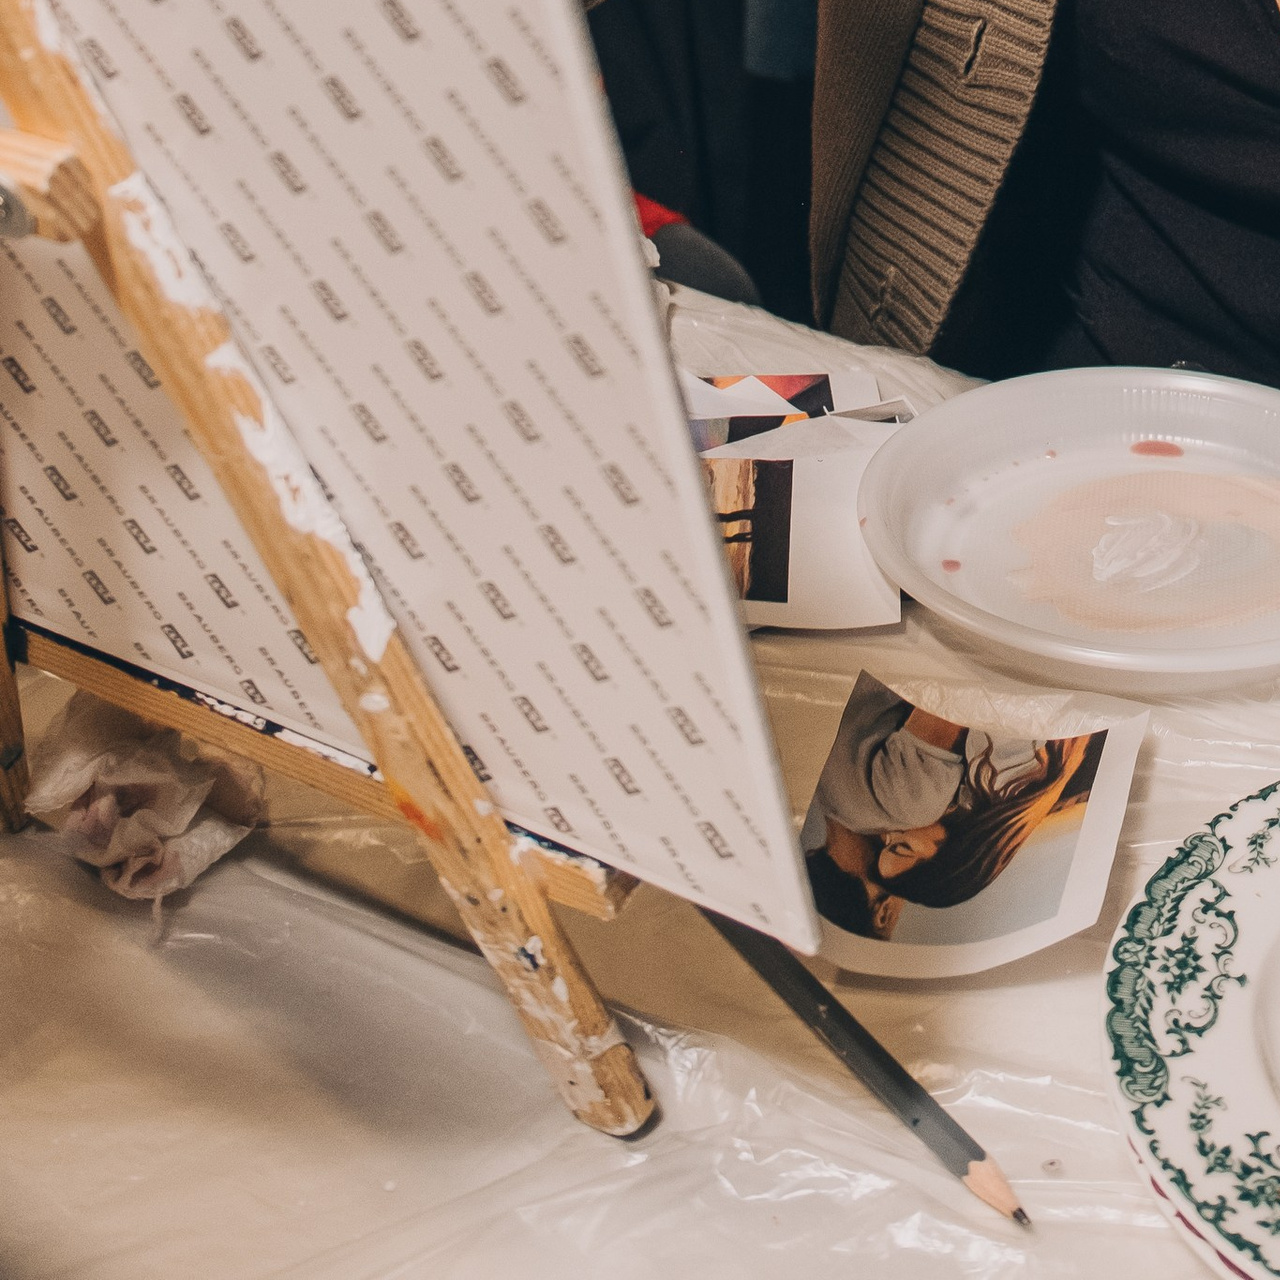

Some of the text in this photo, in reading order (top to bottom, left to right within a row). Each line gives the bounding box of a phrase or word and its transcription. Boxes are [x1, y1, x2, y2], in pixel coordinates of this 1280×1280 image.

[18, 485, 84, 568] BRAUBERG
[96, 537, 163, 621] BRAUBERG
[177, 591, 242, 675] BRAUBERG
